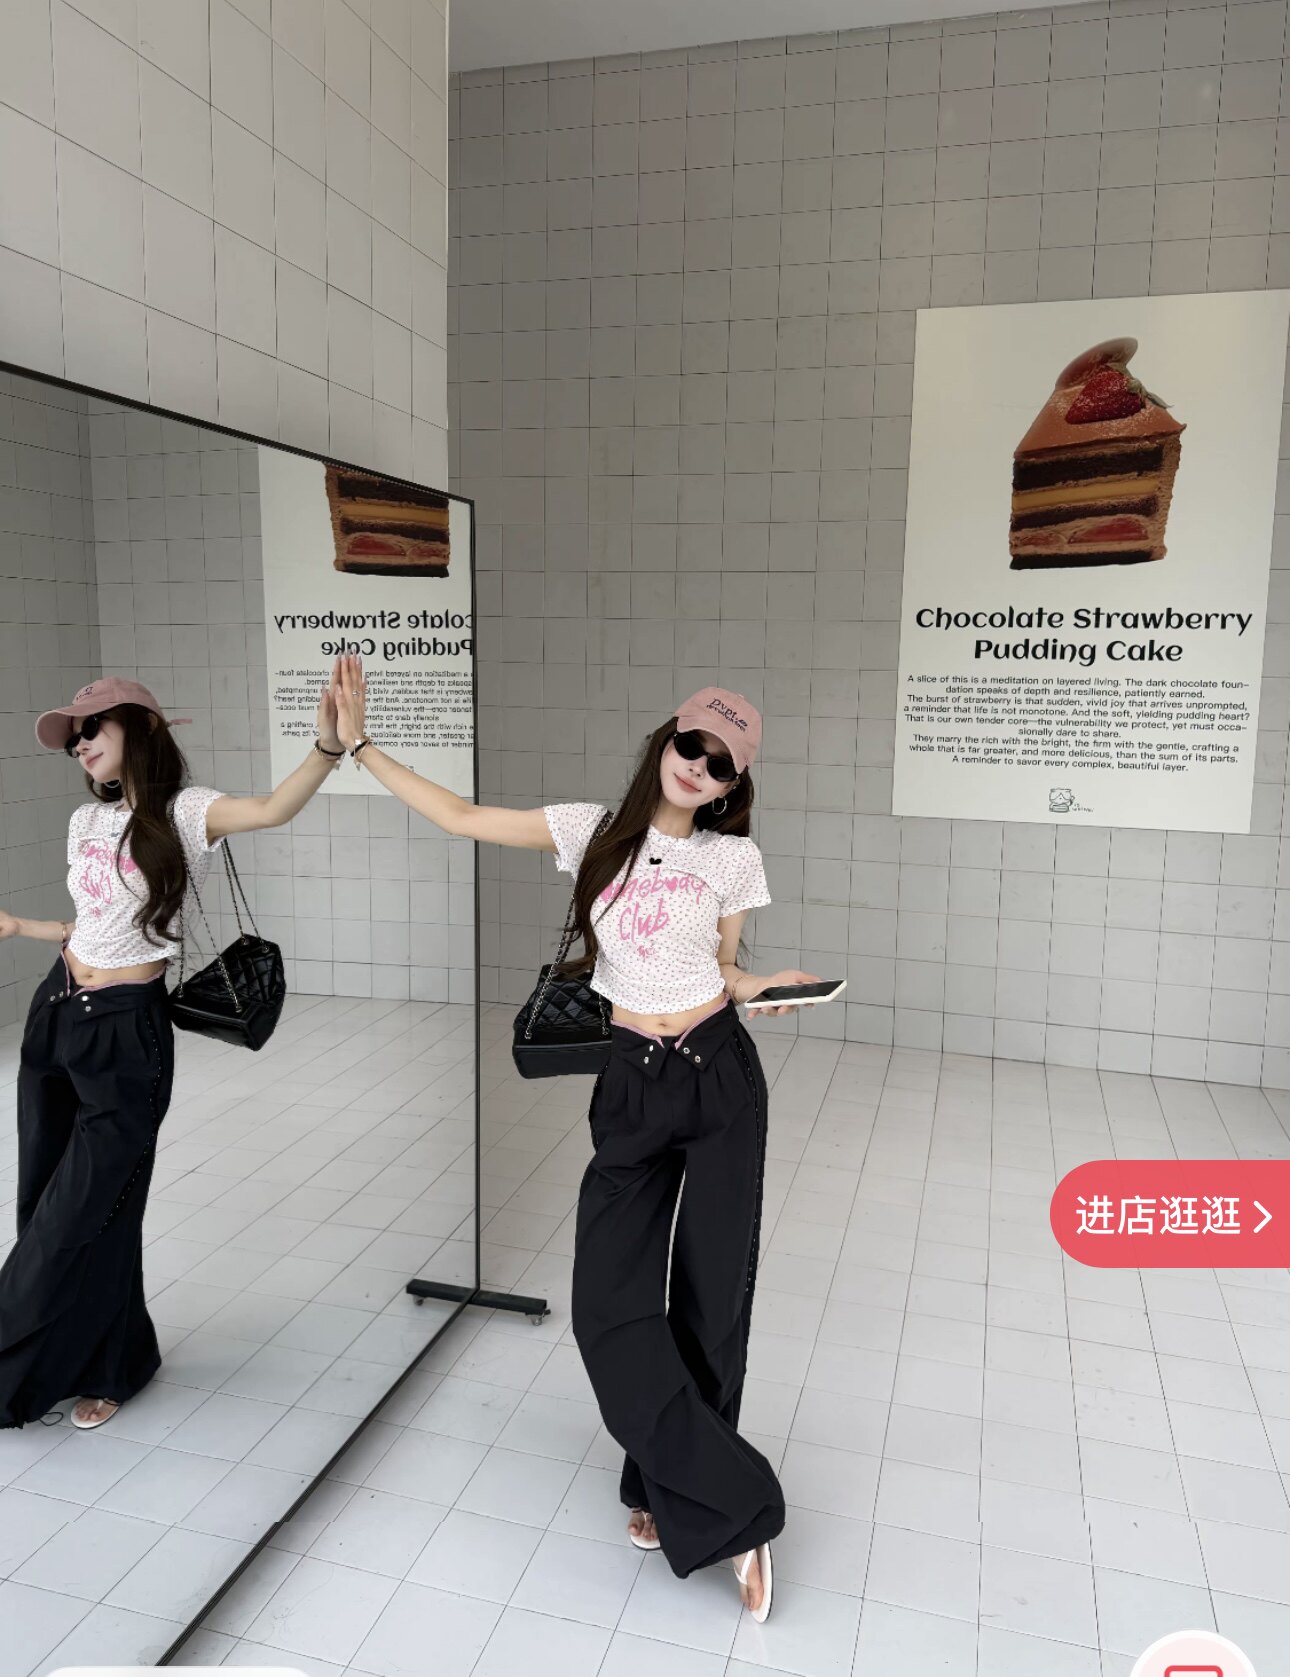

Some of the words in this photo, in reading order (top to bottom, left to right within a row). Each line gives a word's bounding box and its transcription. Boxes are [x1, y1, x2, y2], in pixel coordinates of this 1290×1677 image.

[916, 605, 1064, 630] Chocolate
[1073, 607, 1253, 637] Strawberry
[974, 638, 1097, 667] Pudding
[1106, 639, 1184, 662] Cake
[907, 675, 915, 683] A
[917, 675, 938, 683] slice
[952, 676, 969, 684] this
[971, 676, 979, 684] is
[990, 676, 1039, 685] meditation
[1057, 677, 1092, 687] layered
[1094, 678, 1122, 687] living.
[1125, 678, 1143, 686] The
[1145, 679, 1168, 687] dark
[1170, 679, 1219, 688] chocolate
[946, 686, 974, 694] dation
[977, 686, 1009, 696] speaks
[1011, 687, 1022, 695] of
[1024, 687, 1051, 696] depth
[1054, 687, 1071, 696] and
[1074, 688, 1122, 698] resilience,
[1125, 689, 1167, 699] patiently
[1169, 690, 1205, 699] earned.
[907, 695, 924, 703] The
[926, 696, 949, 704] burst
[952, 696, 961, 704] of
[964, 696, 1012, 706] strawberry
[1015, 697, 1023, 705] is
[1025, 698, 1044, 706] that
[1046, 698, 1084, 707] sudden,
[1086, 699, 1108, 707] vivid
[1111, 701, 1126, 709] joy
[1128, 700, 1148, 708] that
[1150, 700, 1183, 708] arrives
[1186, 701, 1248, 711] unprompted,
[911, 705, 952, 713] reminder
[953, 706, 971, 714] that
[974, 706, 989, 714] life
[1001, 707, 1017, 715] not
[1019, 707, 1069, 716] monotone.
[1071, 708, 1091, 717] And
[1093, 709, 1109, 717] the
[1111, 709, 1133, 719] soft,
[1136, 710, 1174, 720] yielding
[1176, 711, 1217, 721] pudding
[1219, 712, 1251, 721] heart?
[904, 714, 925, 722] That
[928, 715, 935, 723] is
[976, 716, 1006, 725] tender
[1055, 718, 1113, 729] vulnerability
[1131, 721, 1170, 731] protect,
[1172, 722, 1188, 731] yet
[1190, 722, 1215, 731] must
[1018, 727, 1054, 737] sionally
[1056, 728, 1078, 737] dare
[1080, 729, 1091, 737] to
[1093, 730, 1122, 738] share.
[914, 734, 935, 744] They
[937, 736, 962, 744] marry
[965, 735, 980, 744] the
[981, 736, 999, 744] rich
[1002, 736, 1021, 745] with
[1024, 737, 1039, 745] the
[1041, 737, 1071, 748] bright,
[1075, 739, 1090, 747] the
[1093, 739, 1112, 748] firm
[1114, 740, 1135, 748] with
[1137, 741, 1154, 749] the
[1156, 741, 1189, 752] gentle,
[1191, 743, 1230, 754] crafting
[909, 744, 935, 752] whole
[937, 745, 955, 753] that
[957, 745, 966, 753] is
[968, 746, 981, 754] far
[984, 746, 1019, 756] greater,
[1021, 747, 1039, 755] and
[1068, 749, 1113, 759] delicious,
[1116, 750, 1138, 759] than
[1140, 751, 1156, 759] the
[1182, 753, 1193, 761] of
[1196, 753, 1208, 761] its
[1210, 754, 1238, 764] parts.
[952, 755, 960, 764] A
[962, 756, 1002, 765] reminder
[1004, 757, 1014, 765] to
[1017, 759, 1042, 767] savor
[1044, 760, 1070, 769] every
[1072, 760, 1115, 771] complex,
[1118, 762, 1160, 771] beautiful
[1163, 764, 1189, 774] layer.
[620, 897, 670, 944] Club
